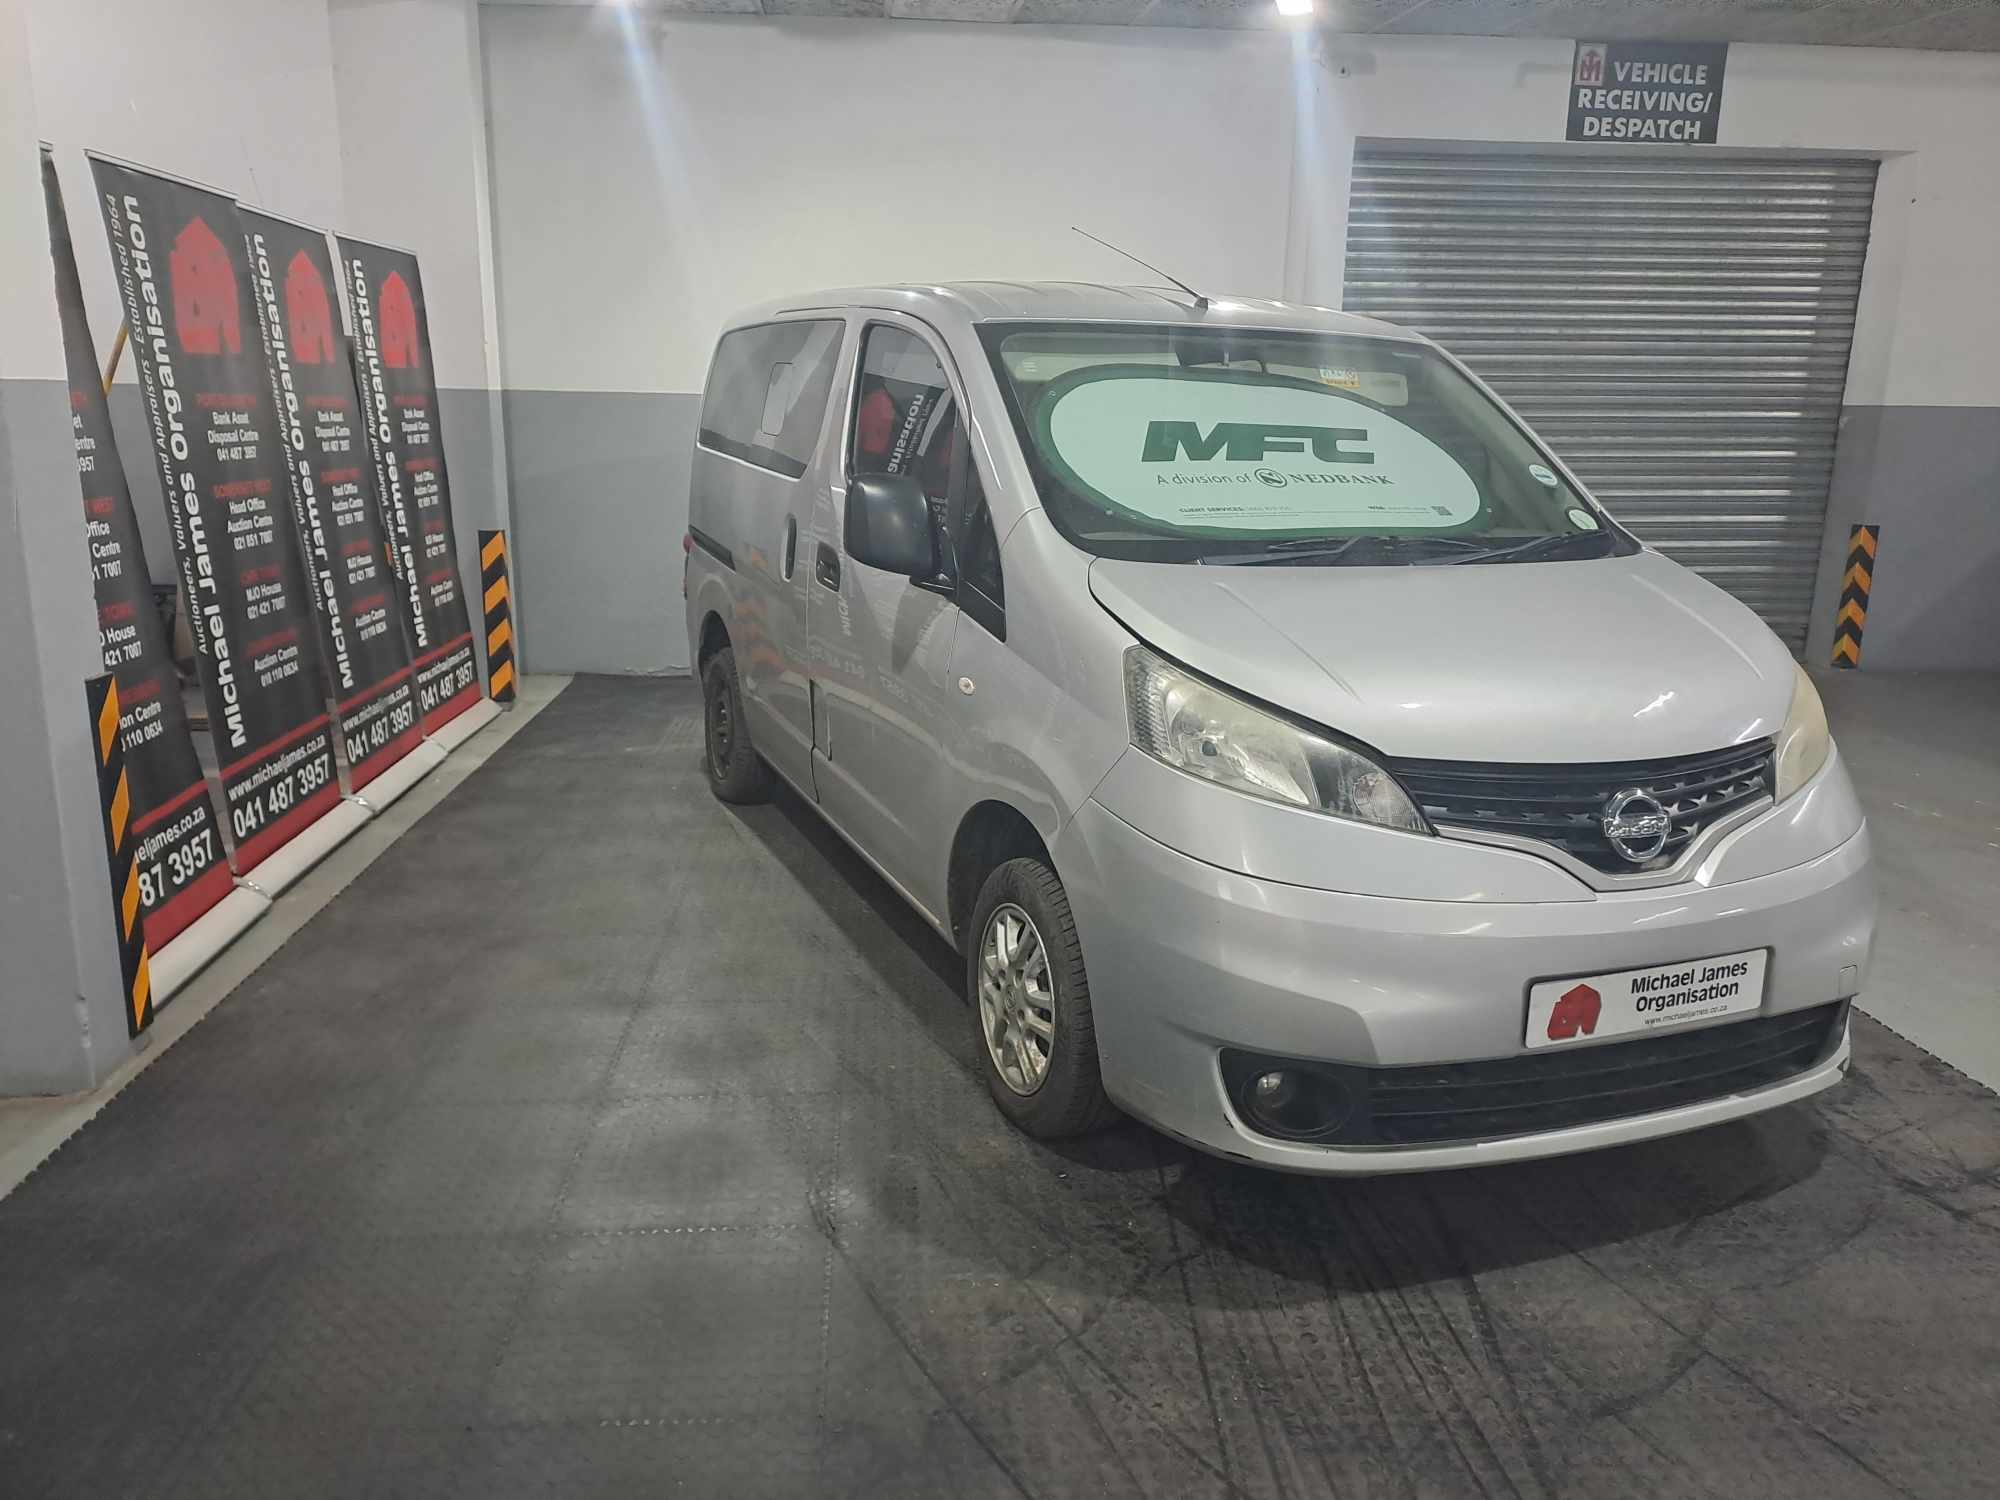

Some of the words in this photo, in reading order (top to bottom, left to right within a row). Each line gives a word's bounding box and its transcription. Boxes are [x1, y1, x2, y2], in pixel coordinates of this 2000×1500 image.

[1614, 61, 1708, 85] VEHICLE
[1577, 88, 1714, 114] RECEIVING/
[1583, 116, 1701, 140] DESPATCH
[106, 194, 124, 238] 1964
[115, 243, 146, 344] Established
[124, 195, 188, 461] Organisation
[253, 233, 304, 452] Organisation
[352, 258, 392, 444] Organisation
[142, 359, 166, 449] Appraisers
[282, 443, 295, 472] and
[370, 438, 382, 461] and
[1141, 420, 1375, 465] MFC
[158, 452, 173, 486] and
[376, 463, 391, 506] Valuers
[384, 450, 409, 538] James
[1156, 474, 1170, 486] A
[1171, 472, 1231, 486] division
[1234, 471, 1251, 484] of
[1288, 473, 1395, 486] NEDBANK
[168, 490, 187, 550] Valuers
[289, 474, 306, 524] Valuers
[299, 459, 328, 561] James
[92, 541, 120, 558] Centre
[180, 471, 217, 594] James
[183, 557, 209, 656] Auctioneers,
[401, 545, 428, 648] Michael
[106, 625, 136, 643] House
[319, 570, 355, 690] Michael
[105, 648, 121, 666] 421
[203, 603, 248, 749] Michael
[135, 701, 161, 721] Centre
[420, 684, 440, 712] 041
[440, 673, 454, 699] 487
[456, 661, 473, 689] 3957
[126, 729, 143, 748] 110
[346, 729, 370, 763] 041
[370, 716, 390, 746] 487
[390, 700, 413, 734] 3957
[228, 734, 327, 802] www.michaeljames.co.za
[233, 796, 265, 838] 041
[268, 775, 294, 815] 487
[297, 753, 330, 796] 3957
[168, 828, 213, 885] 3957
[1631, 968, 1695, 994] Michael
[1698, 962, 1748, 983] James
[1636, 981, 1739, 1012] Organisation
